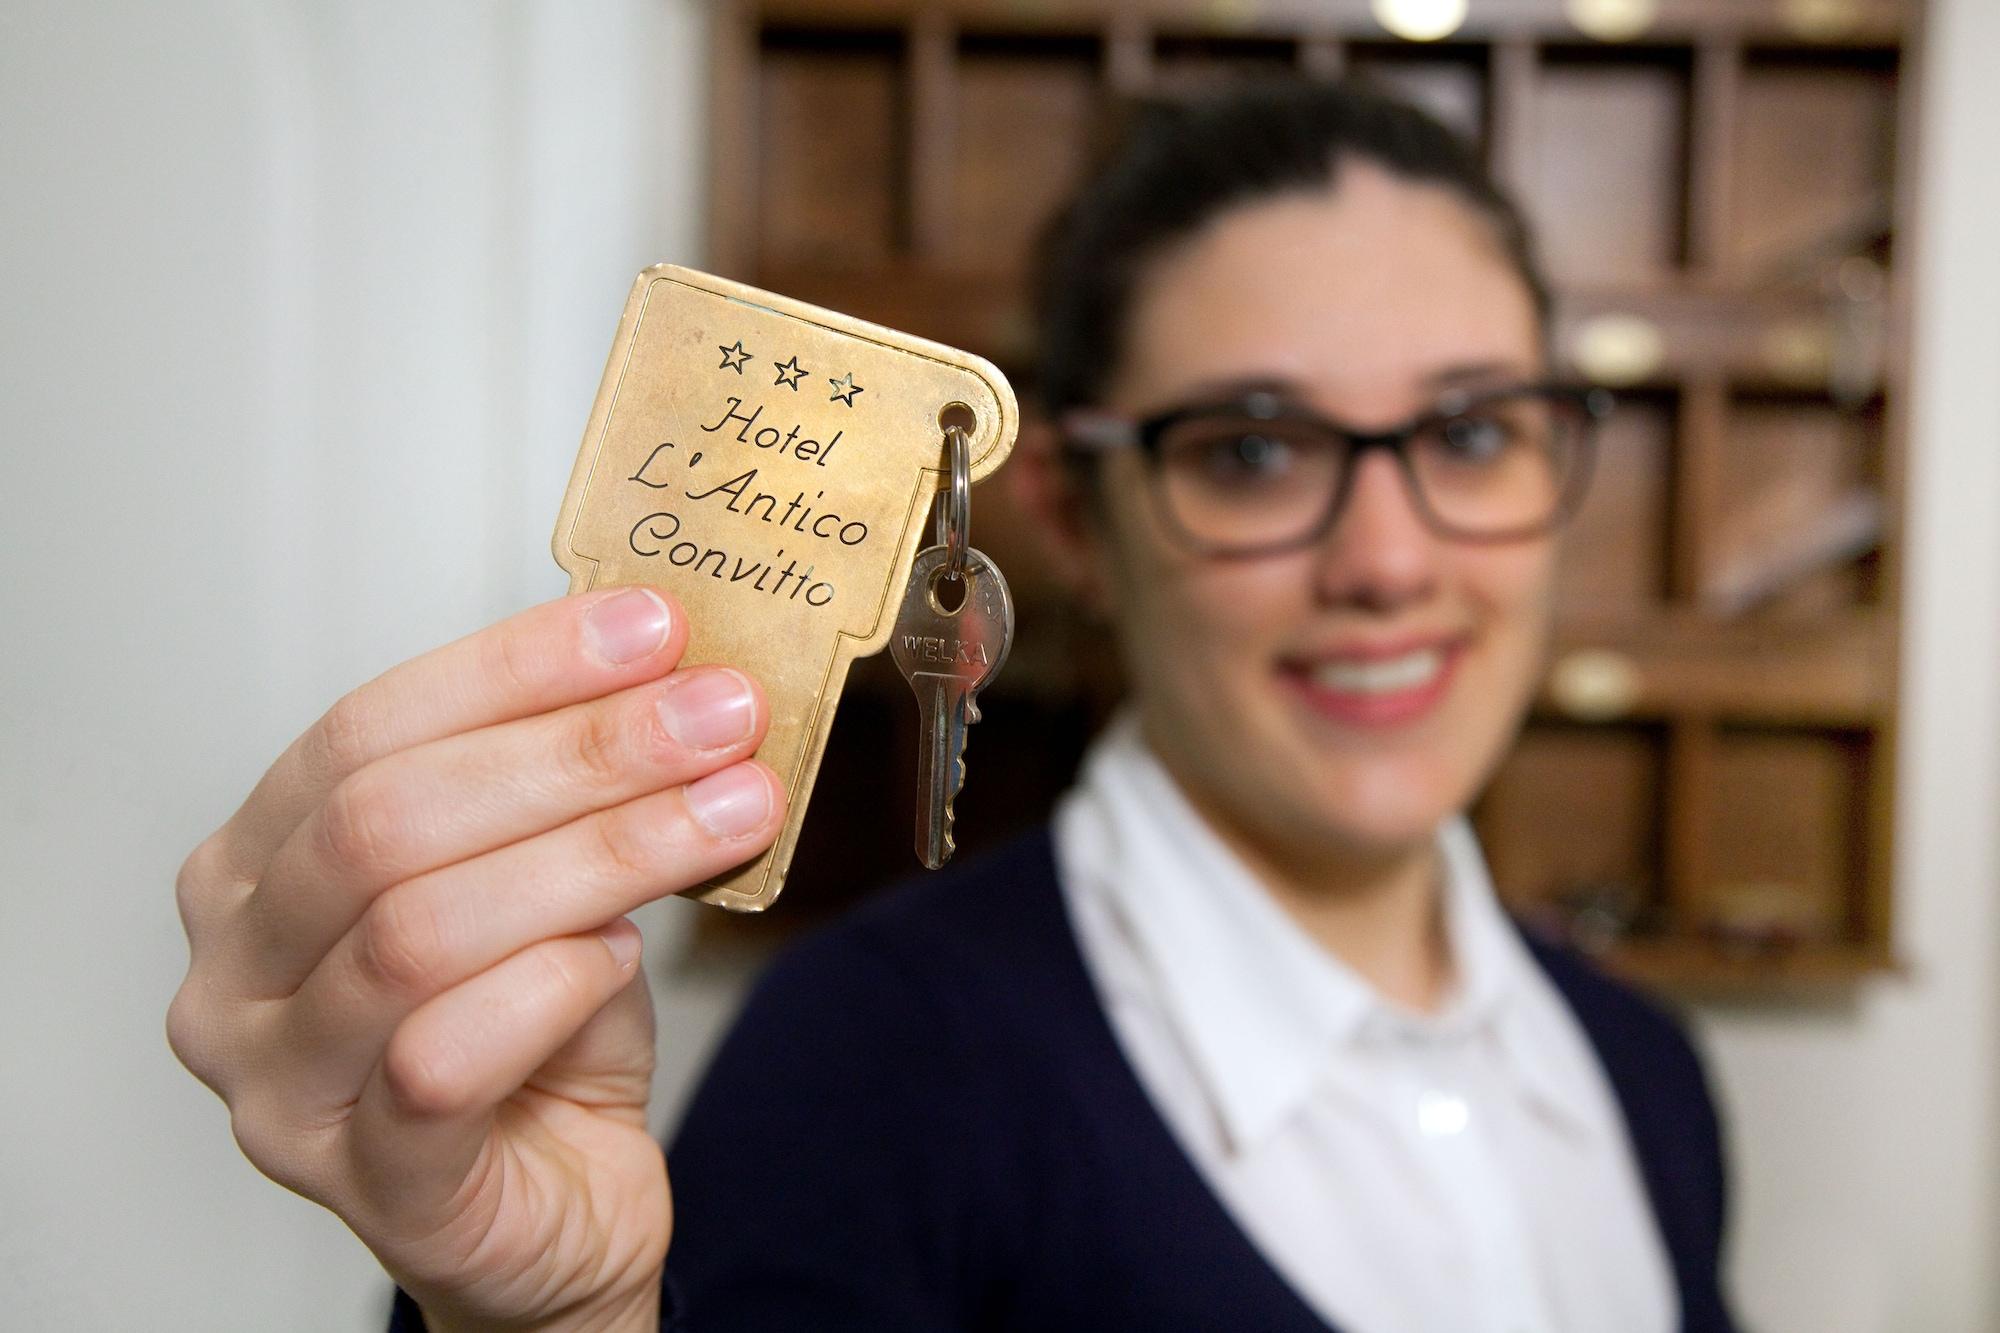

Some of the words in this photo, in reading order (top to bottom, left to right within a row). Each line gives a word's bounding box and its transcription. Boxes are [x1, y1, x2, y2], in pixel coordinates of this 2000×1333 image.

[701, 397, 843, 467] Hotel
[629, 512, 835, 607] Convitto
[903, 634, 988, 666] WELKA
